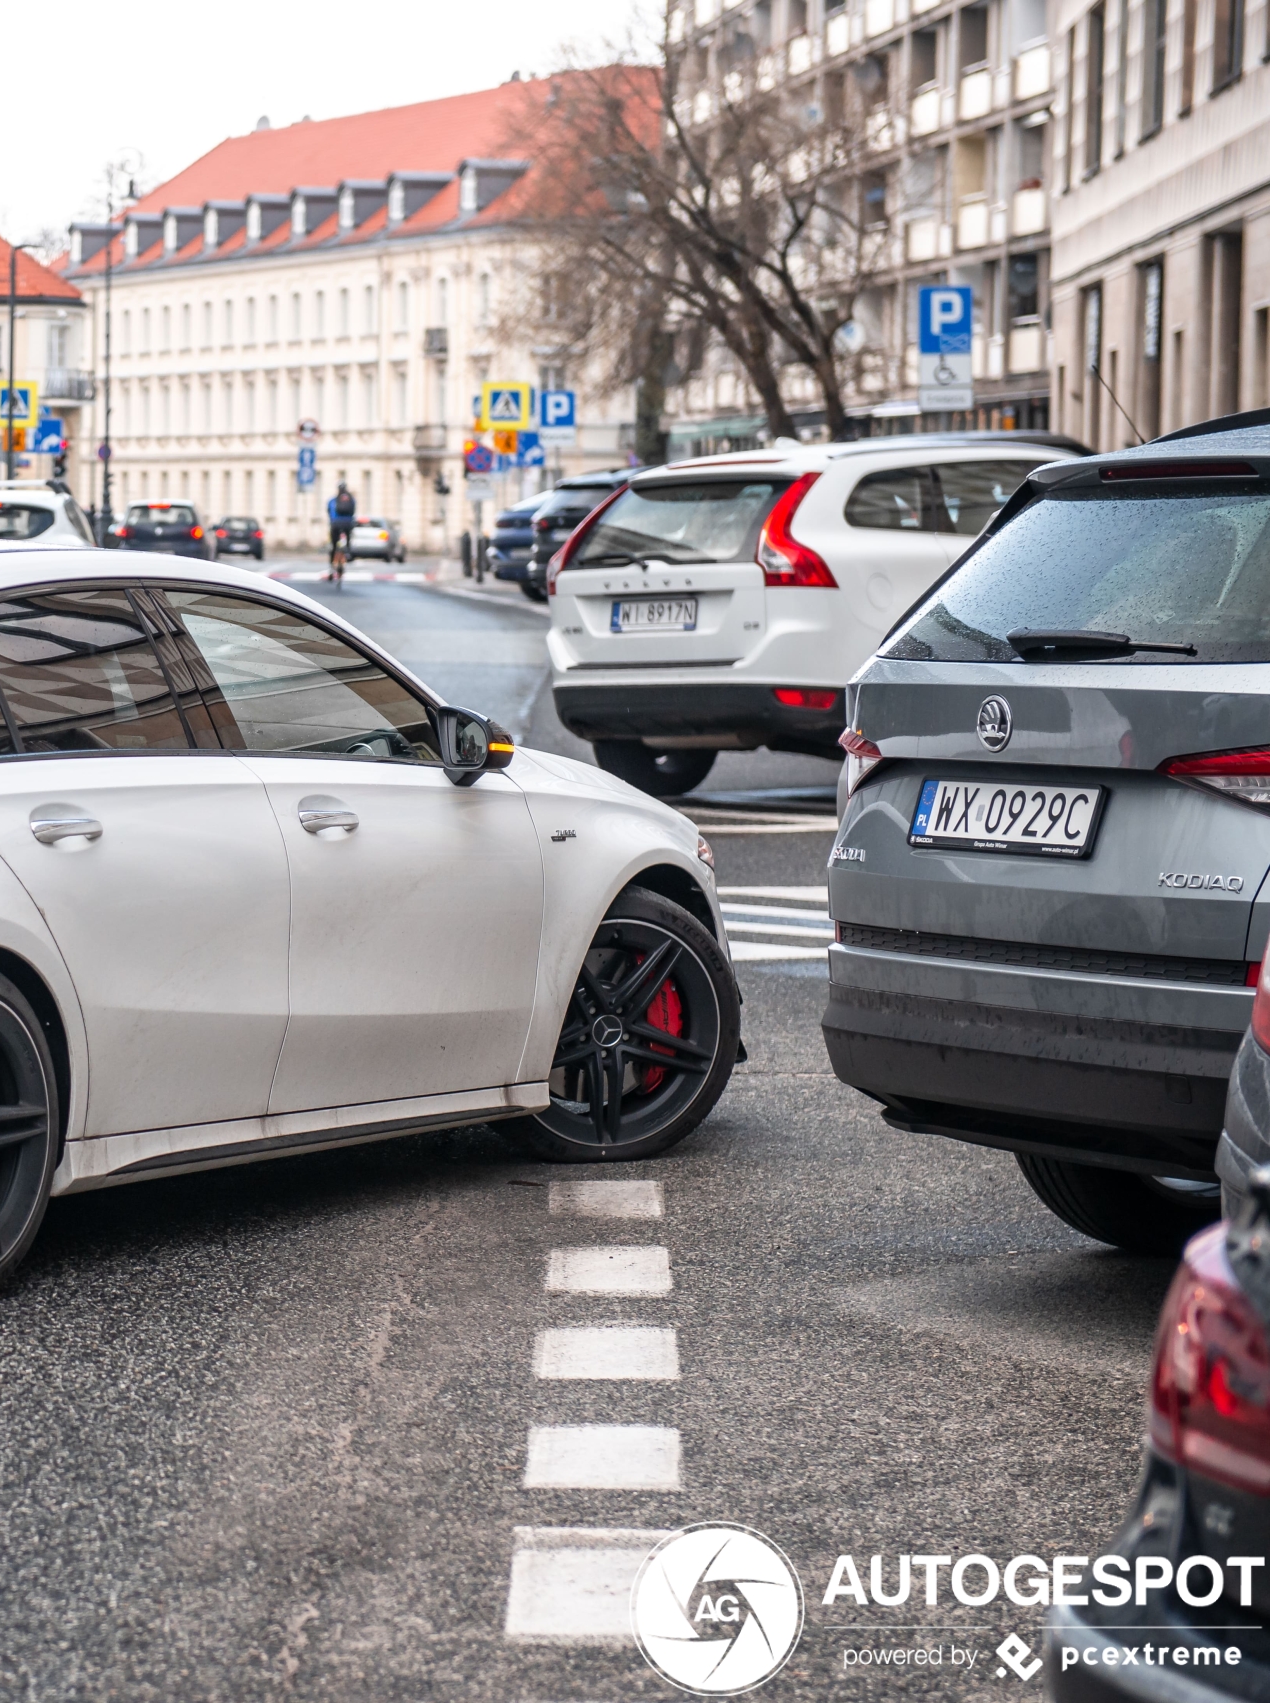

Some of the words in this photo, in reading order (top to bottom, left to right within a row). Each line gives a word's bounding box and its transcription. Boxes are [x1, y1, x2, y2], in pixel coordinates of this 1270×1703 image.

[931, 291, 965, 336] P
[546, 394, 570, 425] P
[647, 602, 693, 623] 8917N
[916, 814, 927, 827] PL
[934, 786, 980, 833] WX
[984, 788, 1089, 840] 0929C
[1158, 872, 1244, 894] KODIAQ
